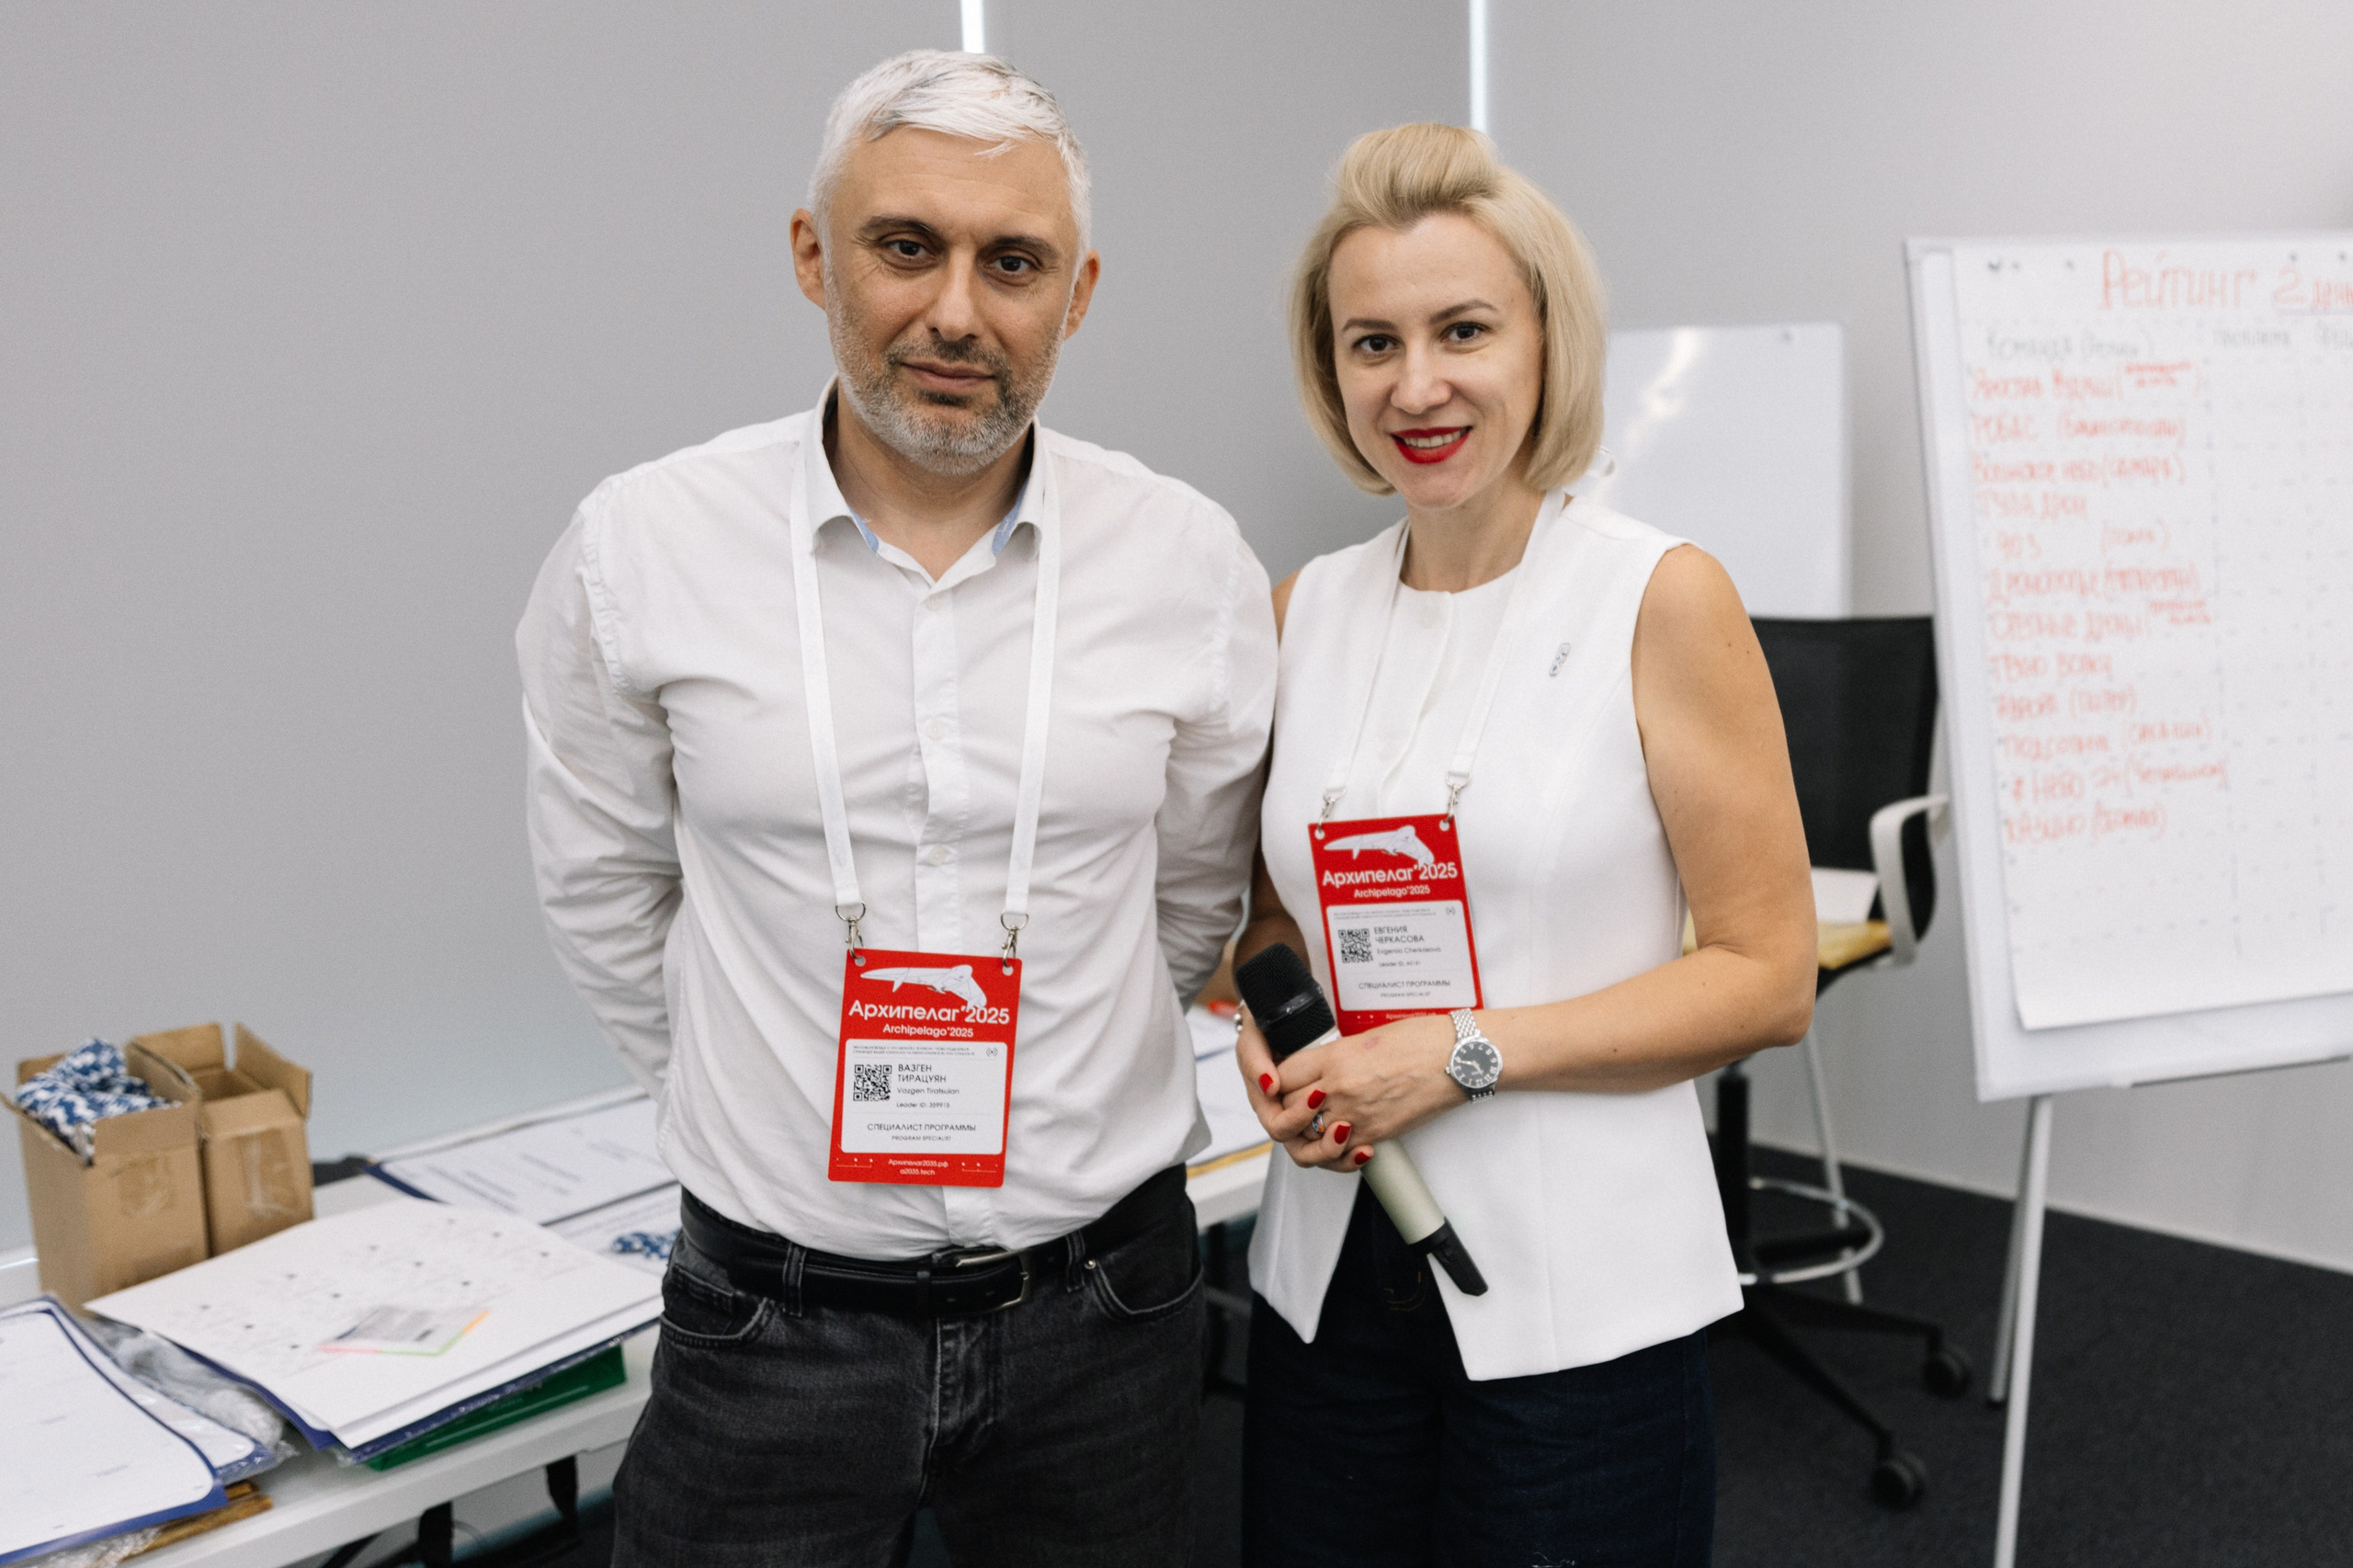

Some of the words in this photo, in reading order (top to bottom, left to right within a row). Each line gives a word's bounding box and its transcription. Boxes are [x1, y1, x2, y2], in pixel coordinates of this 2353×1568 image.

[2274, 265, 2306, 305] 2
[1354, 884, 1430, 898] Archipelago'2025
[1373, 926, 1408, 935] ЕВГЕНИЯ
[1375, 935, 1425, 944] ЧЕРКАСОВА
[1358, 981, 1405, 990] СПЕЦИАЛИСТ
[1405, 980, 1450, 988] ПРОГРАММЫ
[882, 1023, 974, 1038] Archipelago'2025
[898, 1063, 932, 1073] ВАЗГЕН
[897, 1074, 947, 1084] ТИРАЦУЯН
[867, 1123, 923, 1131] СПЕЦИАЛИСТ
